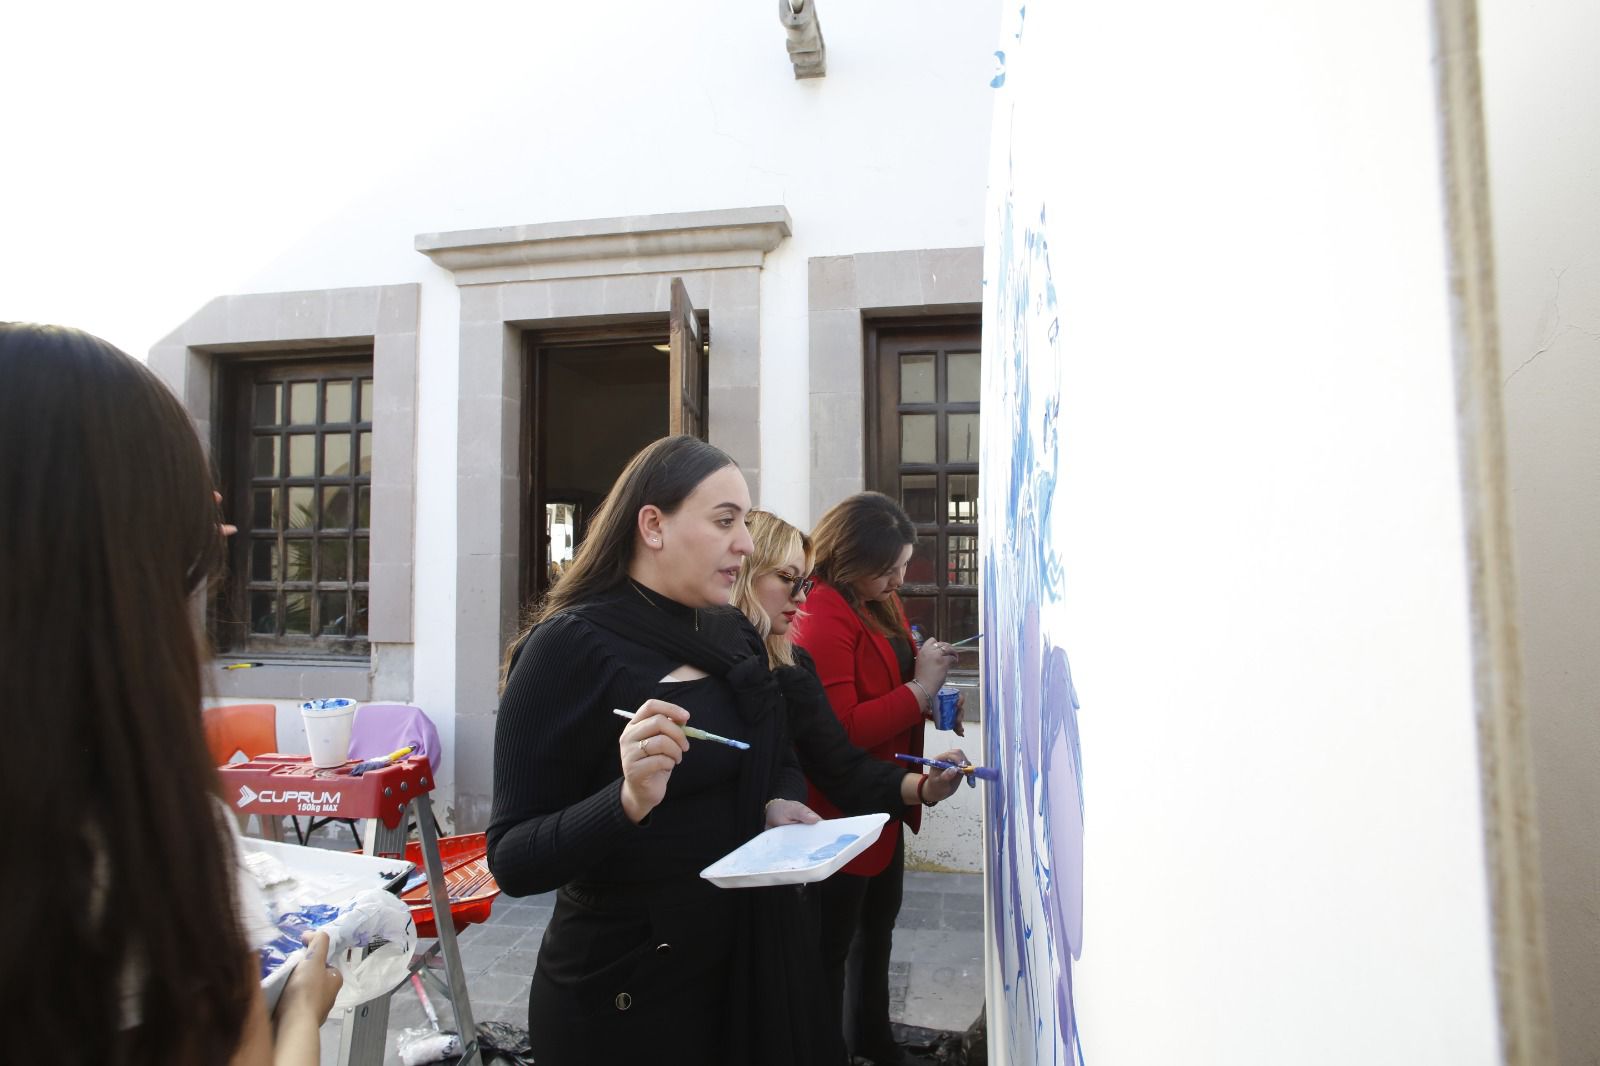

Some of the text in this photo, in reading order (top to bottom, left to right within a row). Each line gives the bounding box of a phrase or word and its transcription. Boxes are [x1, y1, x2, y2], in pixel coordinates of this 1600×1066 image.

[258, 790, 341, 803] CUPRUM
[297, 803, 338, 812] 150kg MAX
